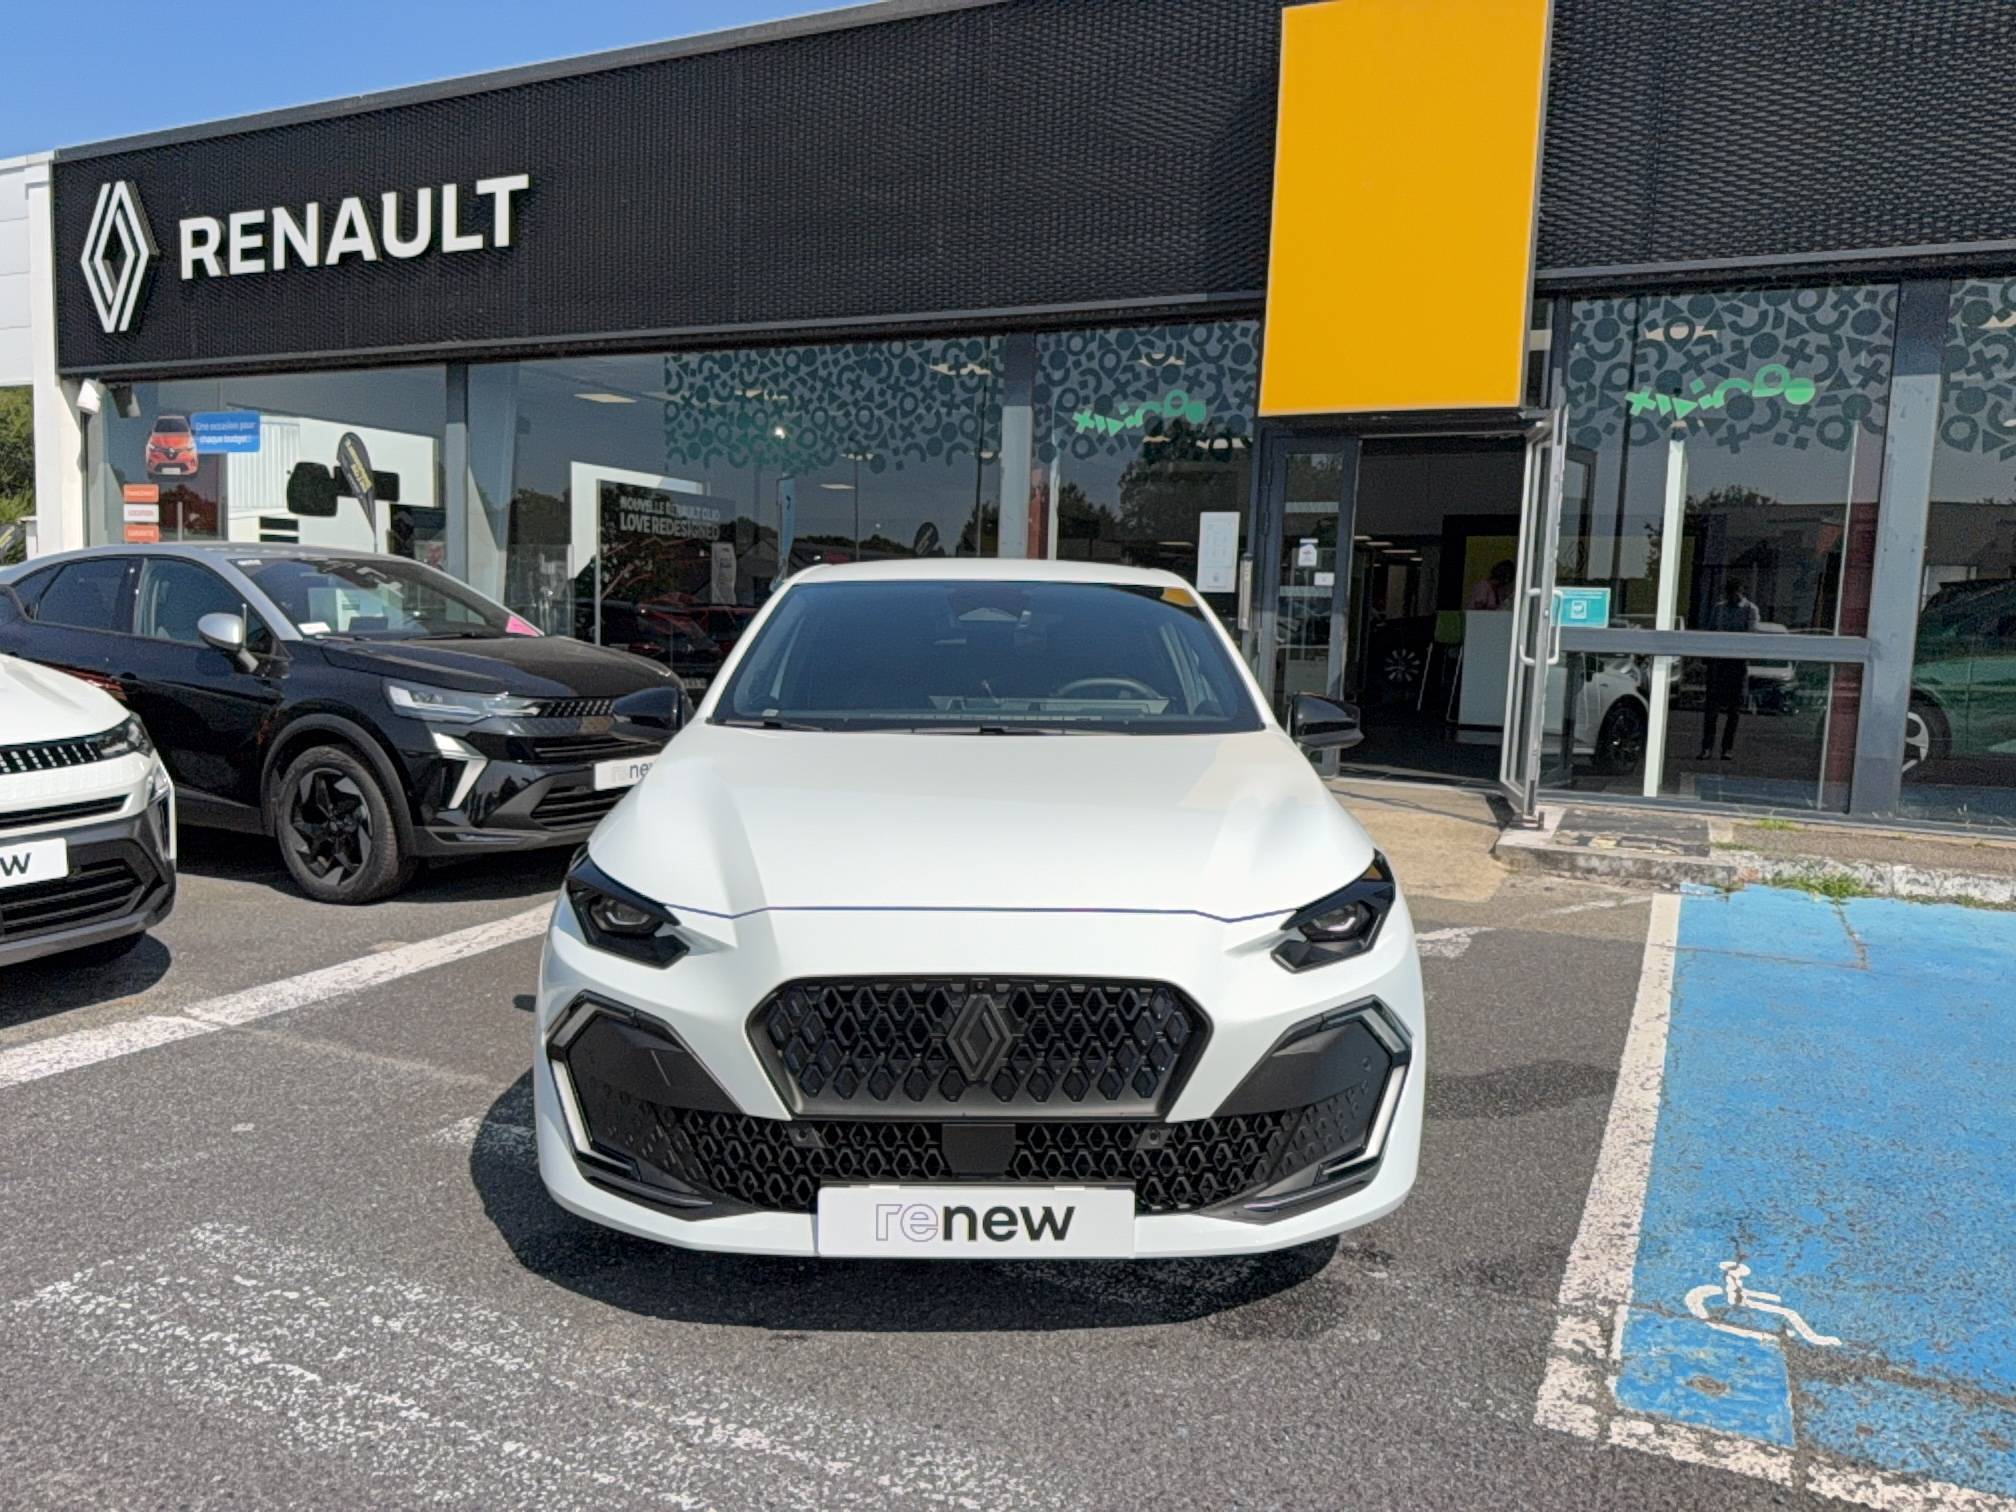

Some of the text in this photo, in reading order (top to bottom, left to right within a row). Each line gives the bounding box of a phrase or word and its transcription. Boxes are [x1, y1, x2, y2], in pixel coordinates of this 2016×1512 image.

[180, 174, 529, 280] RENAULT
[620, 495, 665, 514] NOUVELLE
[620, 512, 720, 540] LOVE REDESIGNED
[875, 1203, 1076, 1243] renew
